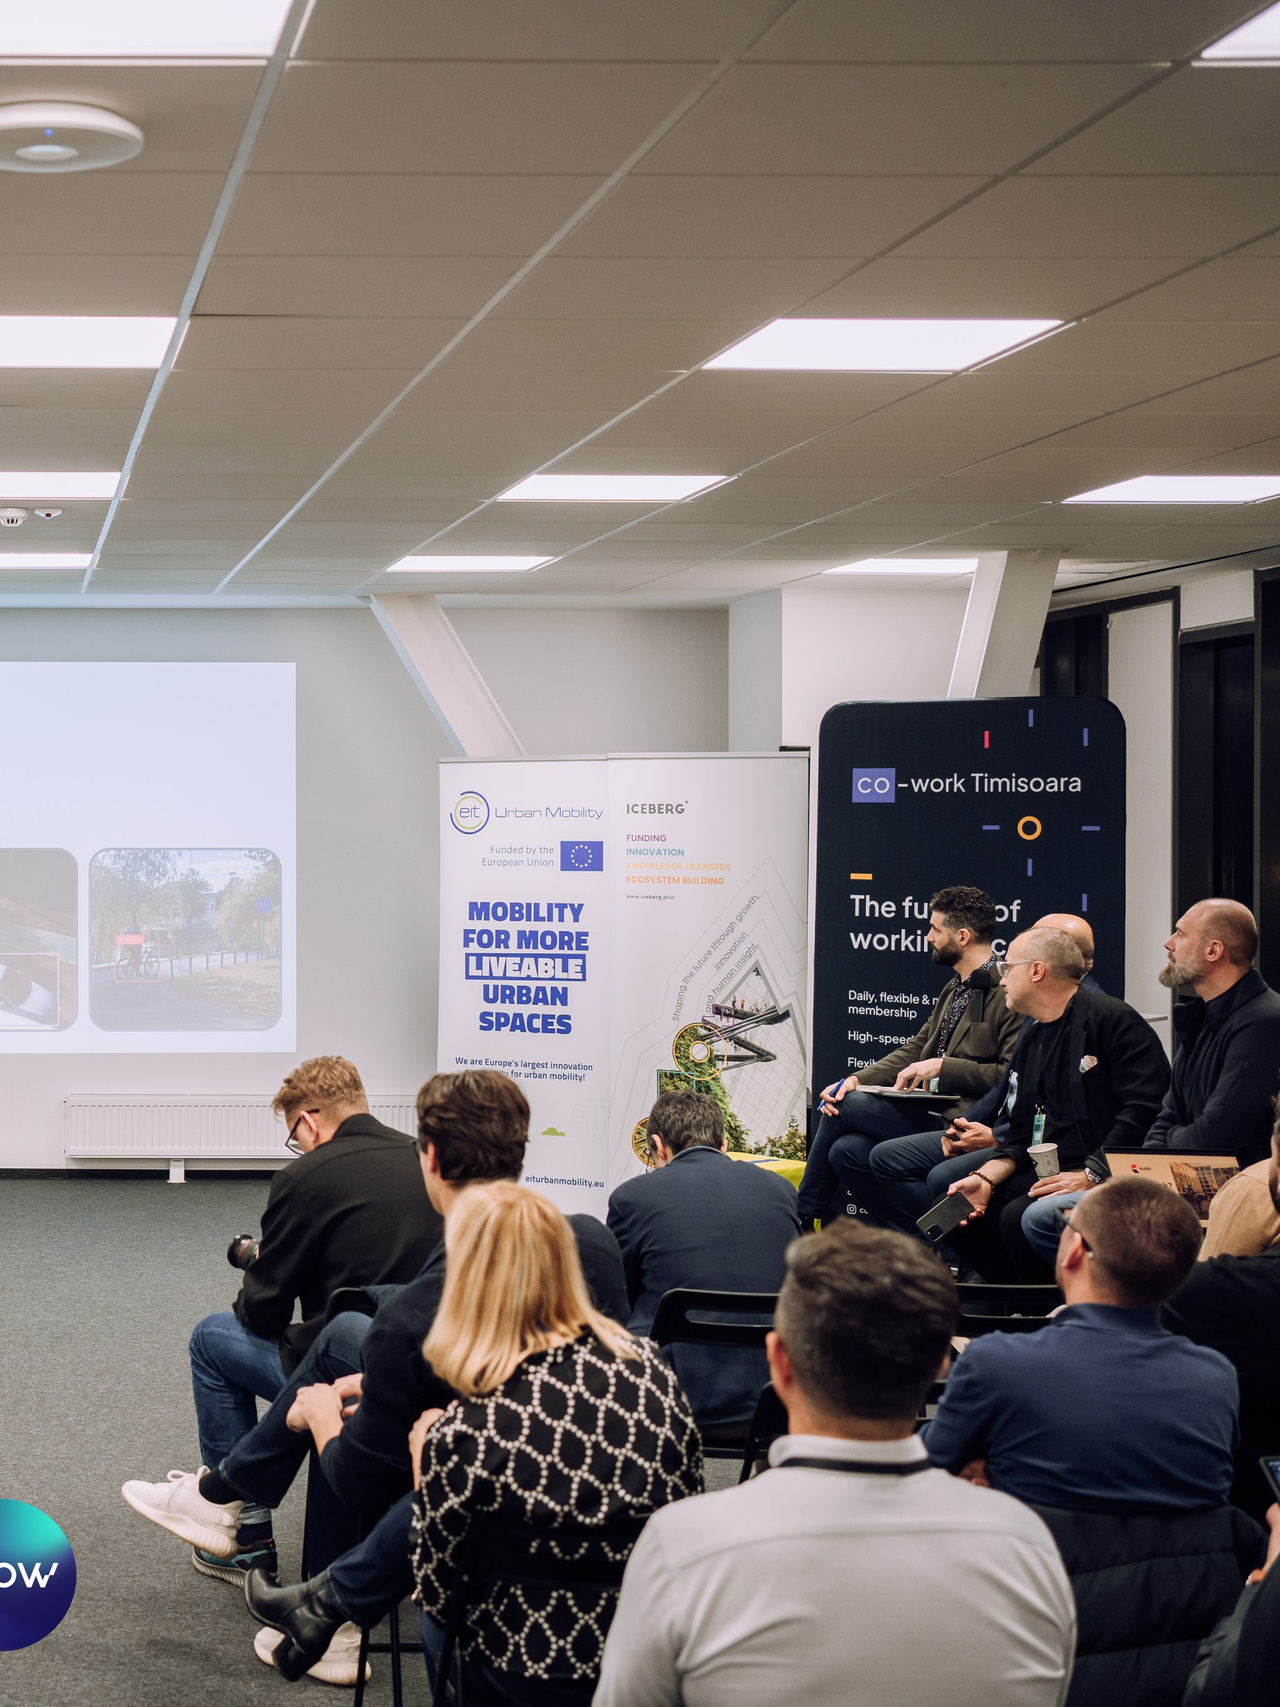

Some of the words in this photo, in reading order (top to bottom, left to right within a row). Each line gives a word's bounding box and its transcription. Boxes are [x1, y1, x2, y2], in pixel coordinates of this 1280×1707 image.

[970, 773, 1082, 793] Timisoara
[459, 805, 480, 819] eit
[494, 807, 542, 818] Urban
[545, 806, 604, 820] Mobility
[626, 834, 667, 842] FUNDING
[490, 845, 523, 854] Funded
[526, 845, 537, 856] by
[539, 845, 554, 854] the
[626, 848, 685, 856] INNOVATION
[482, 858, 524, 868] European
[526, 858, 554, 867] Union
[626, 862, 683, 870] KNOWLEDGE
[685, 863, 731, 871] TRANSFER
[626, 876, 680, 884] ECOSYSTEM
[682, 876, 725, 885] BUILDING
[468, 901, 584, 923] MOBILITY
[849, 894, 896, 918] The
[995, 899, 1021, 923] of
[462, 928, 511, 949] FOR
[516, 929, 589, 951] MORE
[849, 929, 933, 953] worki
[672, 984, 688, 1022] Shaping
[682, 971, 695, 984] the
[692, 949, 712, 972] future
[711, 920, 737, 950] through
[735, 895, 760, 923] growth,
[713, 931, 748, 971] innovation
[468, 956, 584, 980] LIVEABLE
[482, 984, 568, 1007] URBAN
[705, 994, 714, 1013] and
[711, 968, 737, 995] human
[848, 989, 878, 1004] Daily,
[879, 991, 920, 1004] flexible
[921, 994, 930, 1005] &
[848, 1005, 917, 1020] membership
[479, 1011, 572, 1035] SPACES
[455, 1057, 468, 1065] We
[485, 1058, 519, 1068] Europe's
[520, 1060, 548, 1070] largest
[550, 1062, 593, 1071] innovation
[511, 1070, 522, 1078] for
[524, 1071, 548, 1079] urban
[549, 1072, 585, 1083] mobility!
[525, 1175, 604, 1188] eiturbanmobility.eu
